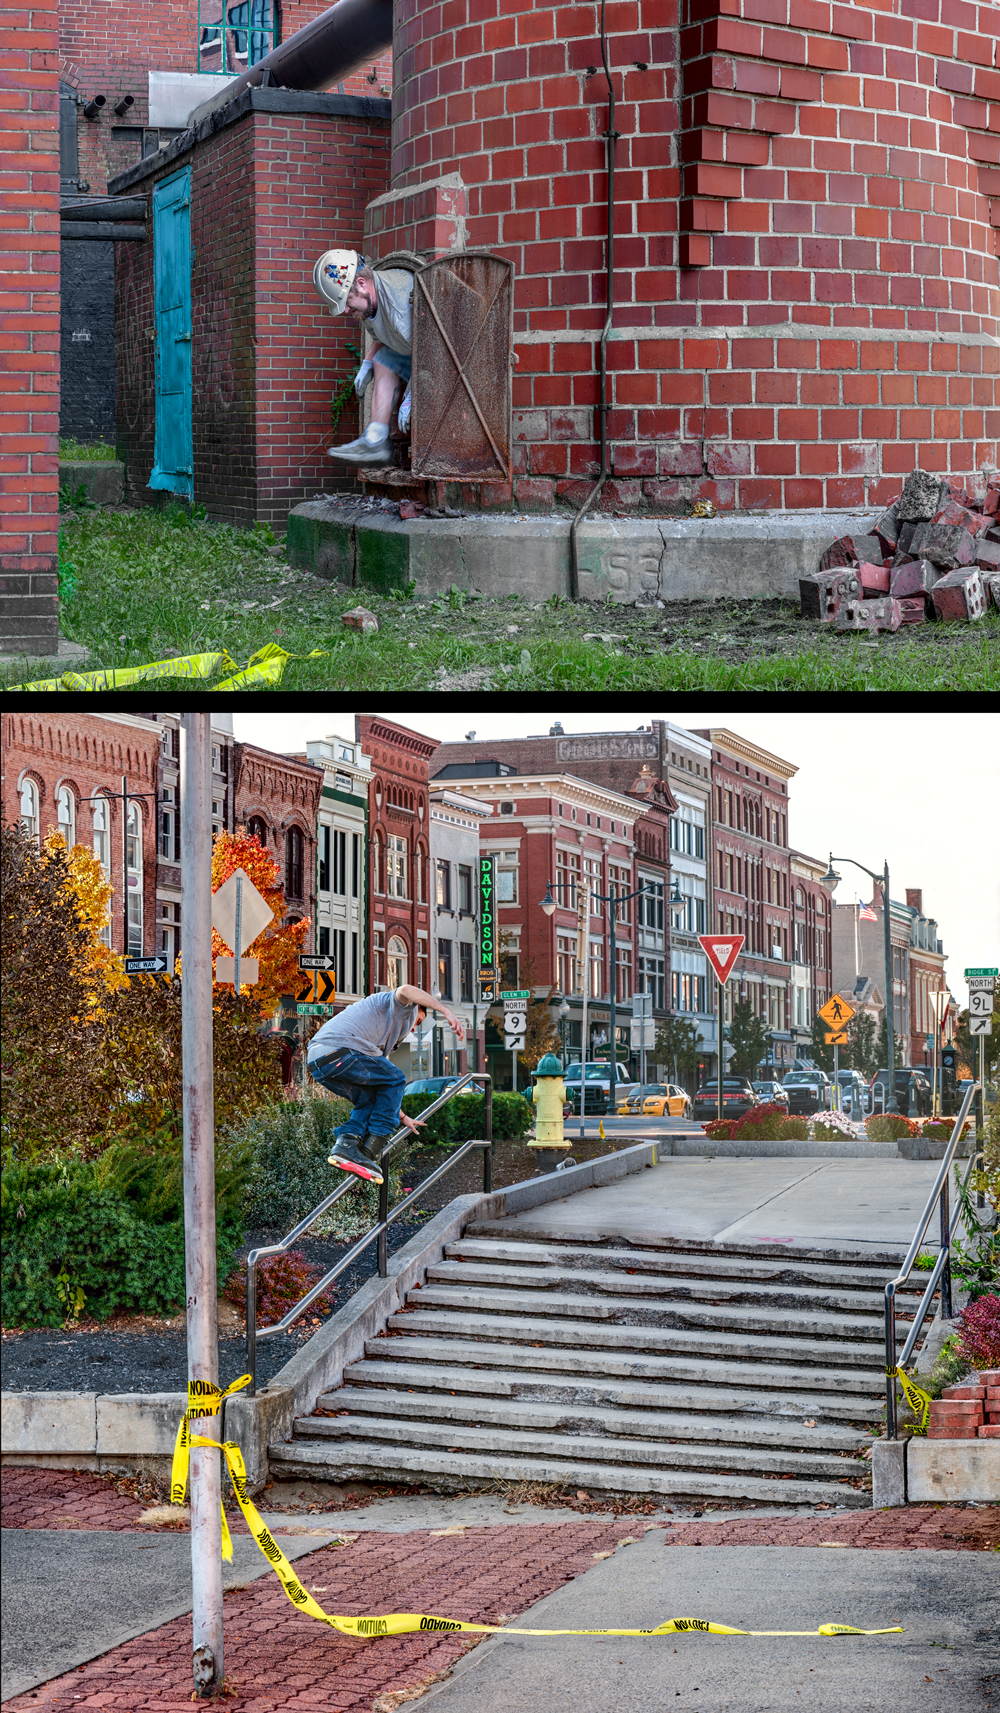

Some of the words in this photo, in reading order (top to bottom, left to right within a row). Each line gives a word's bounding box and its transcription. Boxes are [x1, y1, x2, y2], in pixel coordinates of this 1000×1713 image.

[481, 860, 493, 964] DAVIDSON
[970, 979, 992, 987] NORTH
[505, 1002, 526, 1010] NORTH
[972, 996, 990, 1011] 9L
[511, 1016, 520, 1029] 9
[420, 1617, 462, 1631] CUIDADO
[674, 1618, 710, 1631] CAUTION
